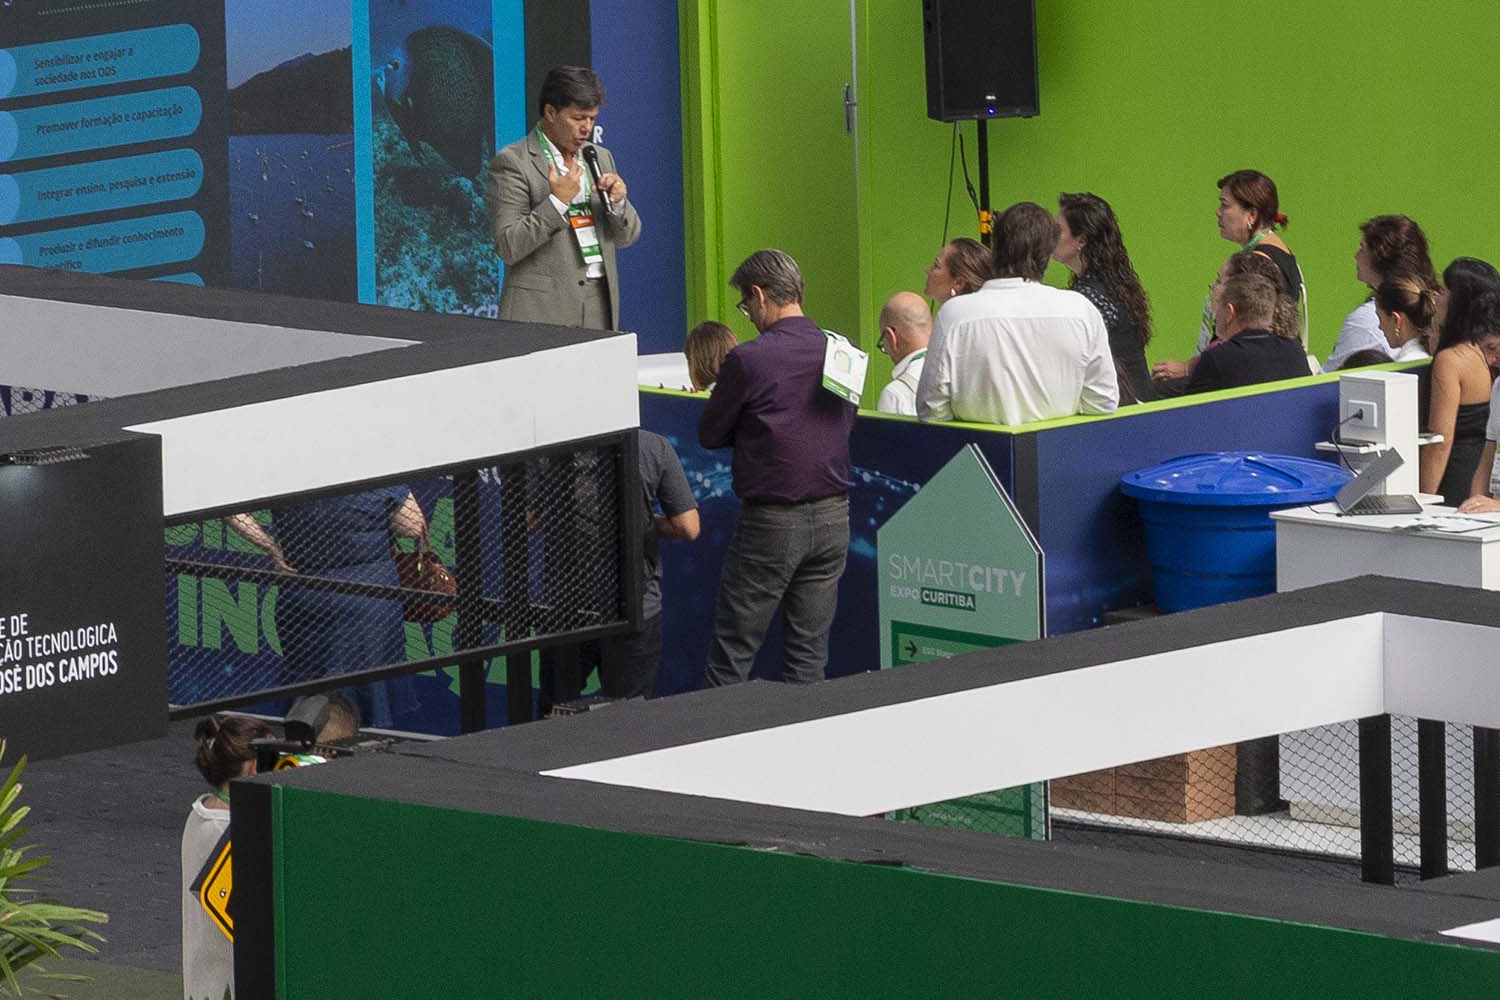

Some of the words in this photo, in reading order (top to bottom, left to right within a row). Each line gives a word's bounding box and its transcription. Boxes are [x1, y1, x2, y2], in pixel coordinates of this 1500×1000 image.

[890, 585, 920, 600] EXPO
[922, 589, 975, 609] CURITIBA
[11, 613, 28, 637] DE
[26, 622, 118, 658] TECNOLOGICA
[26, 661, 55, 690] DOS
[59, 650, 118, 683] CAMPOS
